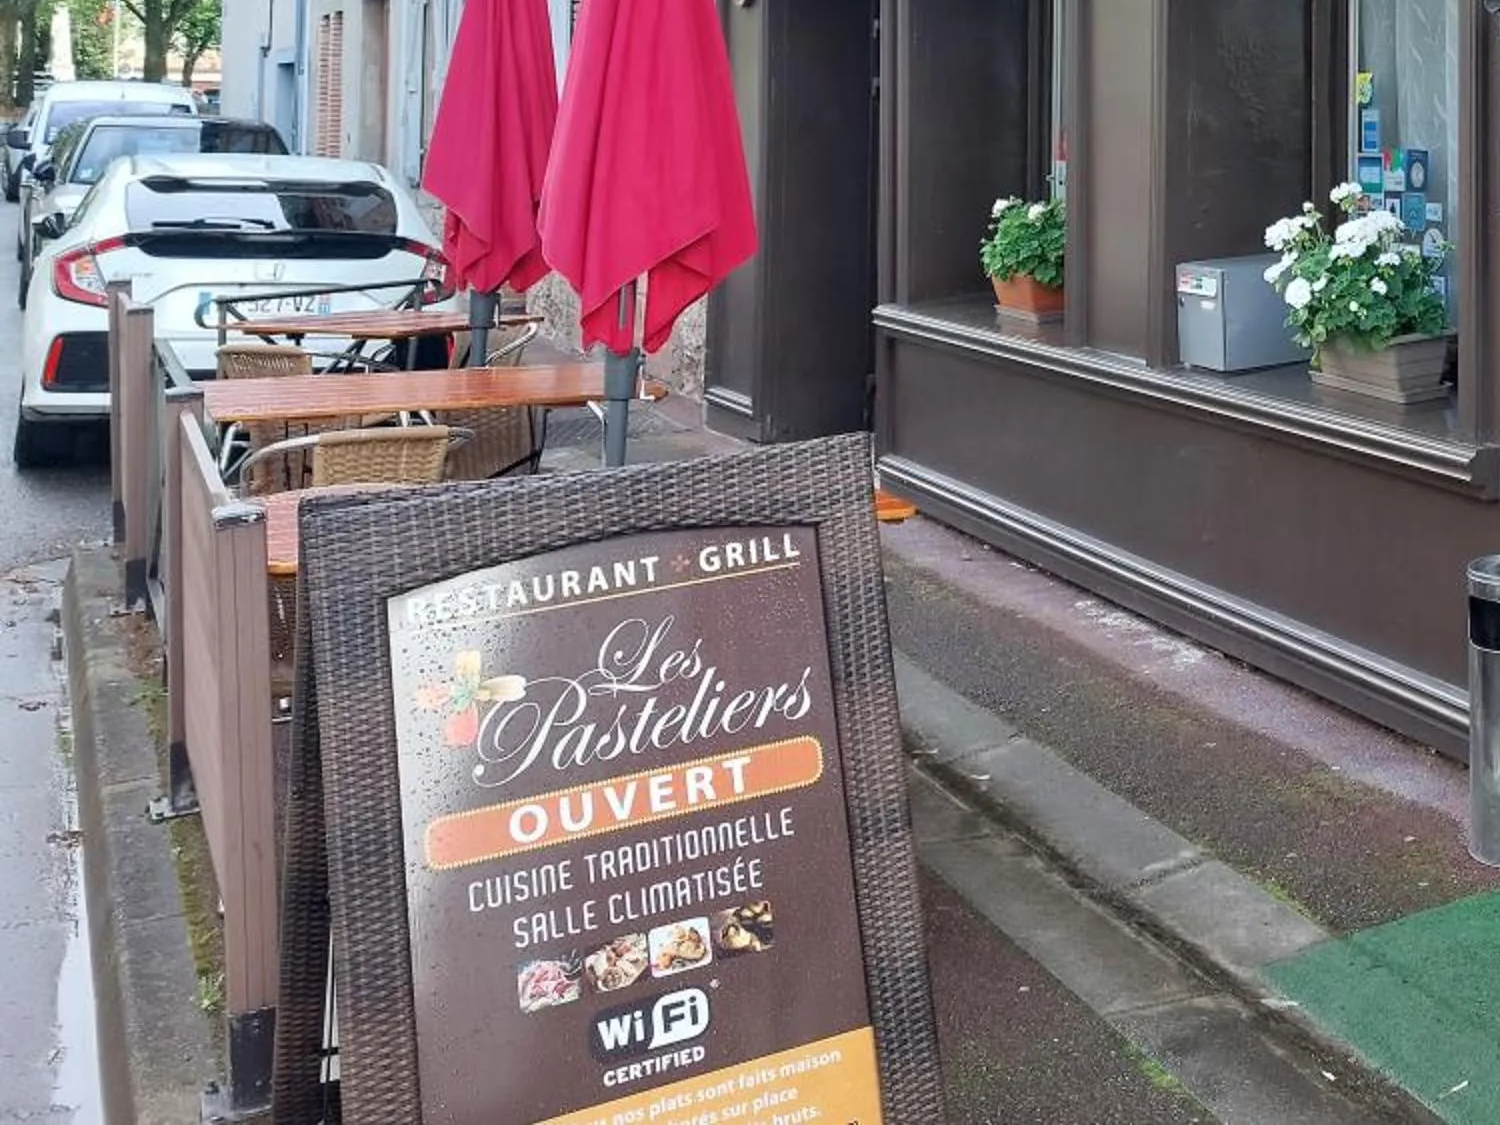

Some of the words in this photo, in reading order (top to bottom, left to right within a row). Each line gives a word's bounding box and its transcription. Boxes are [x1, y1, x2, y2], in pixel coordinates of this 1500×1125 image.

[406, 555, 660, 624] RESTAURANT
[699, 533, 801, 573] GRILL
[588, 614, 704, 696] Les
[471, 666, 813, 789] Pasteliers
[508, 756, 753, 844] OUVERT
[468, 860, 573, 913] CUISINE
[584, 807, 795, 884] TRADITIONNELLE
[512, 900, 598, 948] SALLE
[607, 856, 764, 924] CLIMATISÉE
[603, 1046, 706, 1087] CERTIFIED
[650, 1092, 693, 1121] plats
[696, 1079, 735, 1101] sont
[738, 1068, 777, 1089] faits
[780, 1049, 842, 1076] maison
[721, 1101, 748, 1117] sur
[752, 1086, 799, 1115] place
